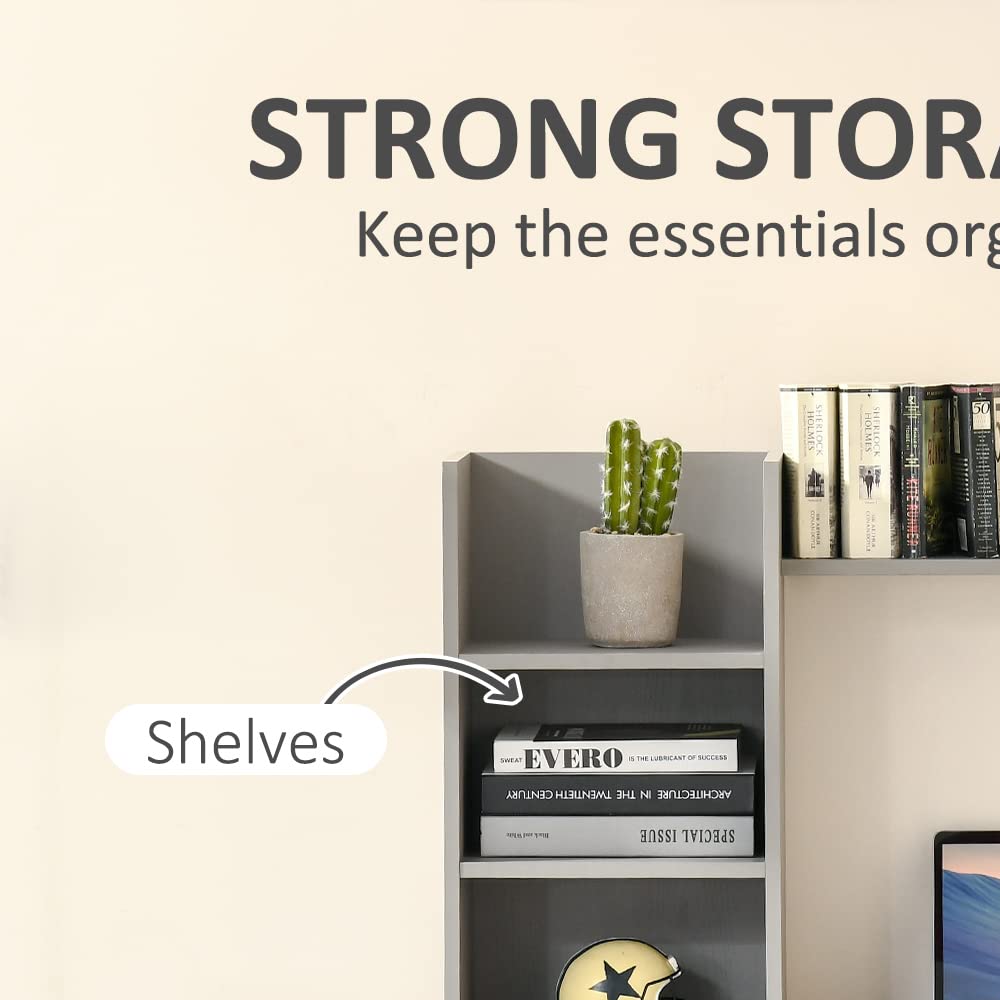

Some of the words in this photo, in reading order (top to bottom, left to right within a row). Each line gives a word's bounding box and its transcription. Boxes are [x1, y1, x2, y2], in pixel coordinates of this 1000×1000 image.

[972, 402, 991, 415] 50
[807, 410, 816, 451] HOLMES
[815, 404, 824, 457] SHERLOCK
[864, 412, 873, 453] HOLMES
[872, 406, 881, 457] SHERLOCK
[523, 748, 624, 770] EVERO
[505, 789, 553, 800] CENTURY
[556, 789, 612, 800] TWENTIETH
[616, 789, 636, 800] THE
[640, 789, 652, 800] IN
[657, 789, 732, 800] ARCHITECTURE
[640, 829, 677, 843] ISSUE
[681, 829, 735, 843] SPECIAL
